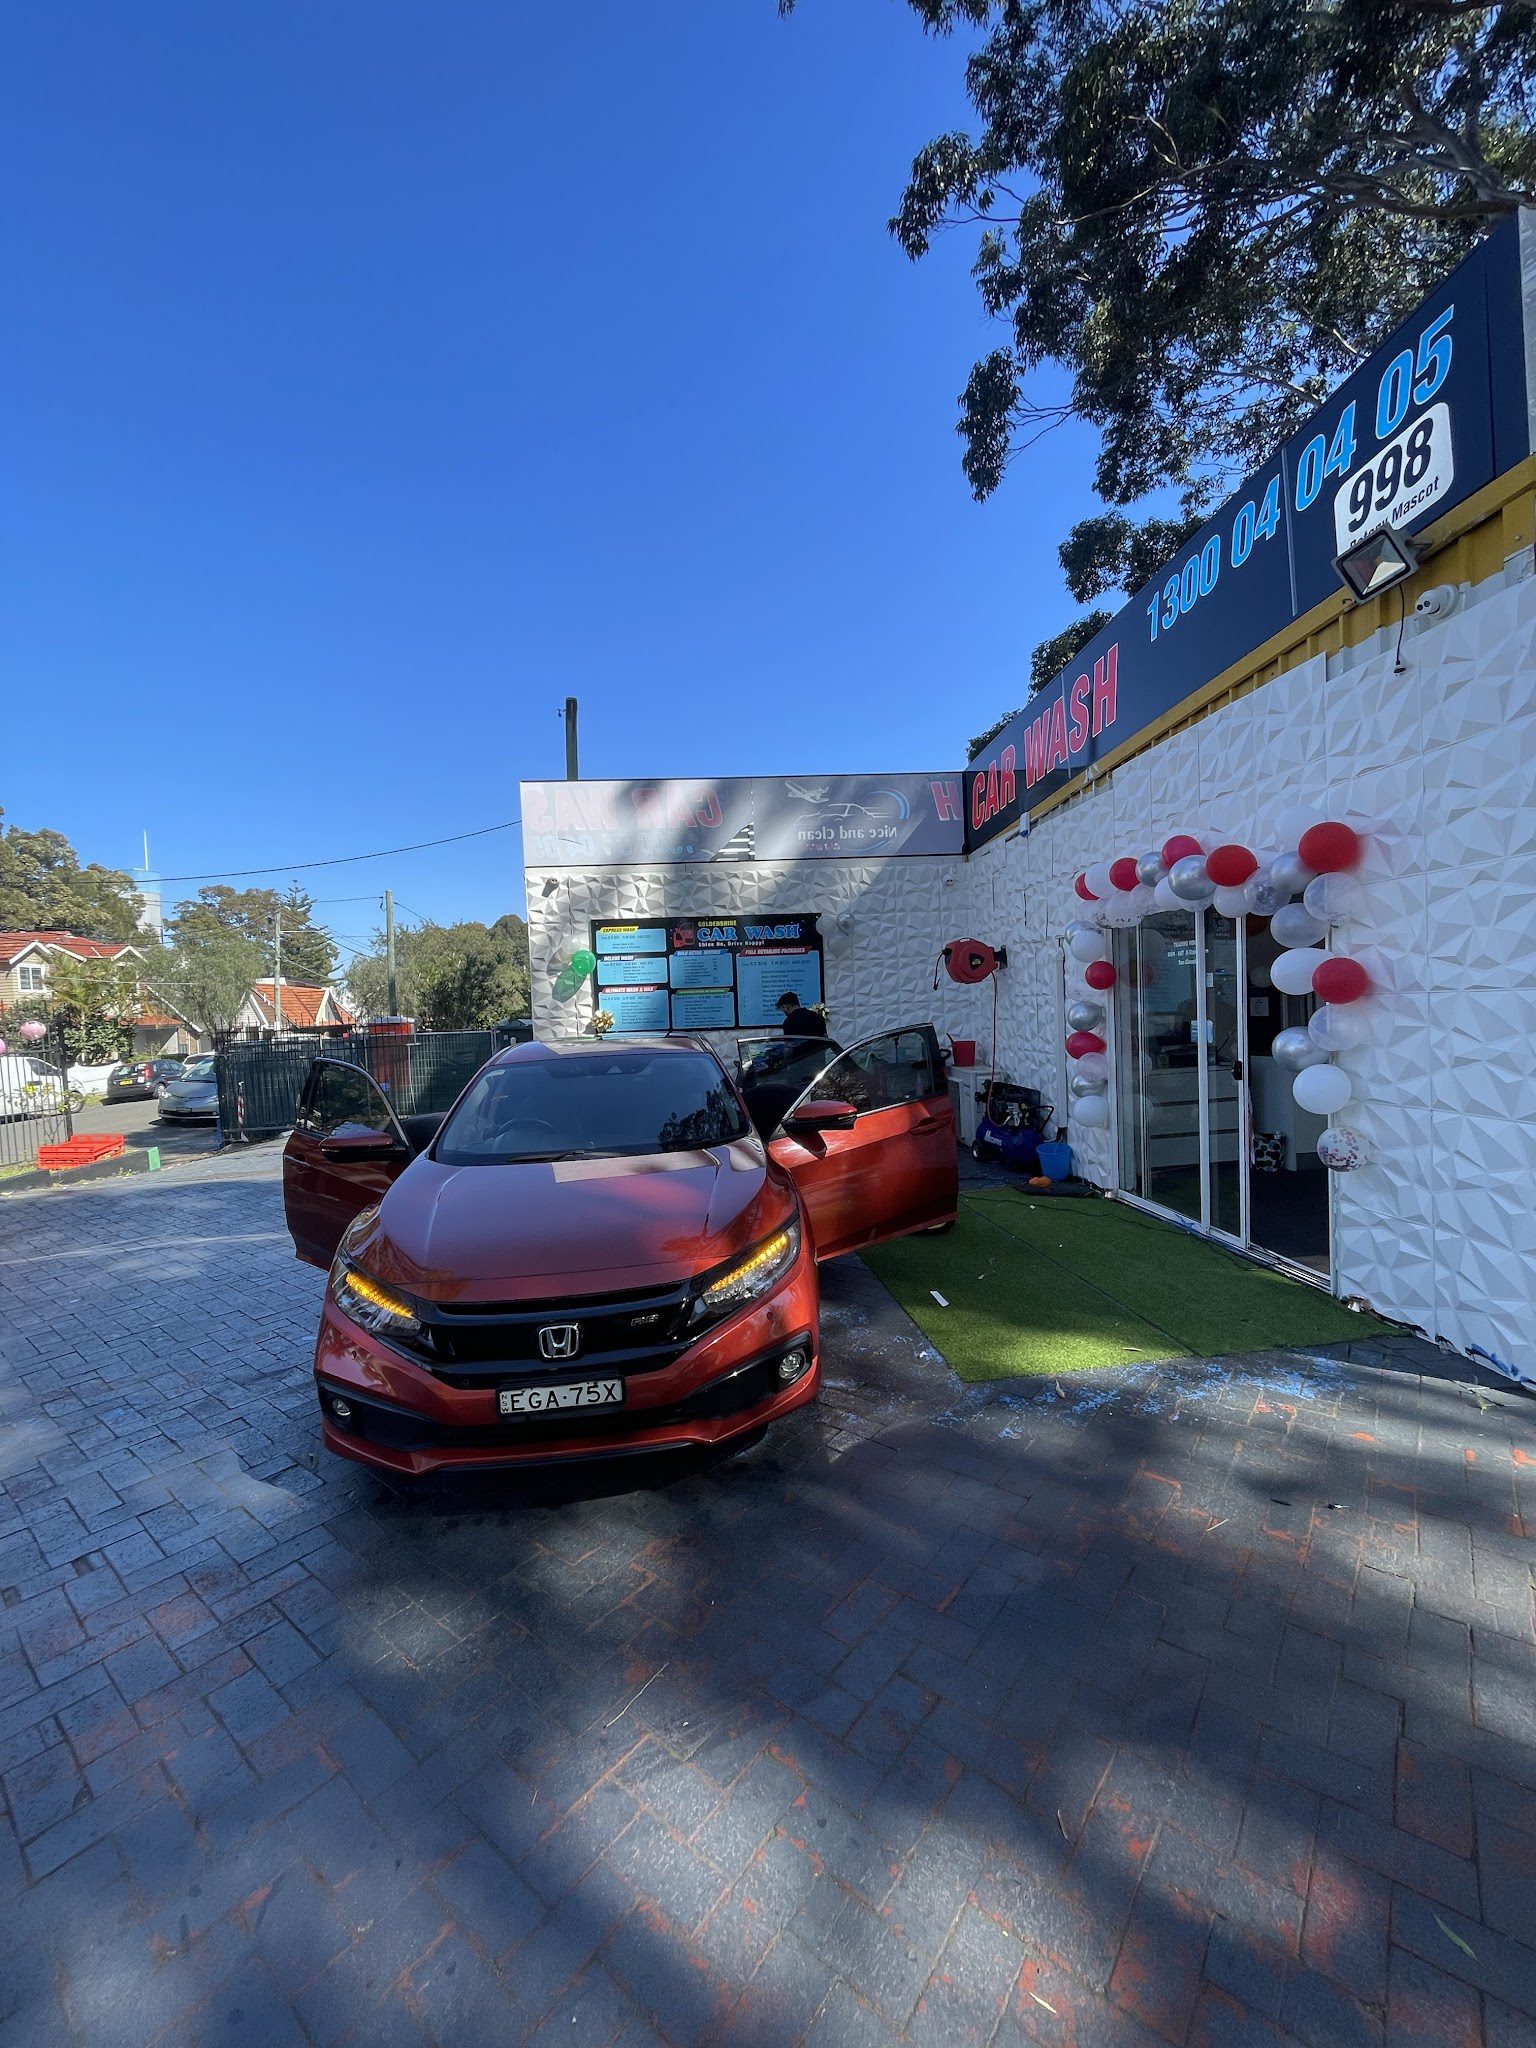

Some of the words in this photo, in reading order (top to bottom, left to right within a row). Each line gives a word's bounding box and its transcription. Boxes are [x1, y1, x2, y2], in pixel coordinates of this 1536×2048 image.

[1147, 534, 1220, 642] 1300
[1231, 473, 1280, 569] 04
[1295, 400, 1356, 511] 04
[1375, 304, 1454, 439] 05
[1348, 417, 1434, 533] 998
[1391, 476, 1439, 523] Mascot
[972, 745, 1016, 830] CAR
[1024, 643, 1119, 789] WASH
[697, 926, 738, 941] CAR
[744, 924, 800, 939] WASH
[501, 1394, 509, 1412] NSW
